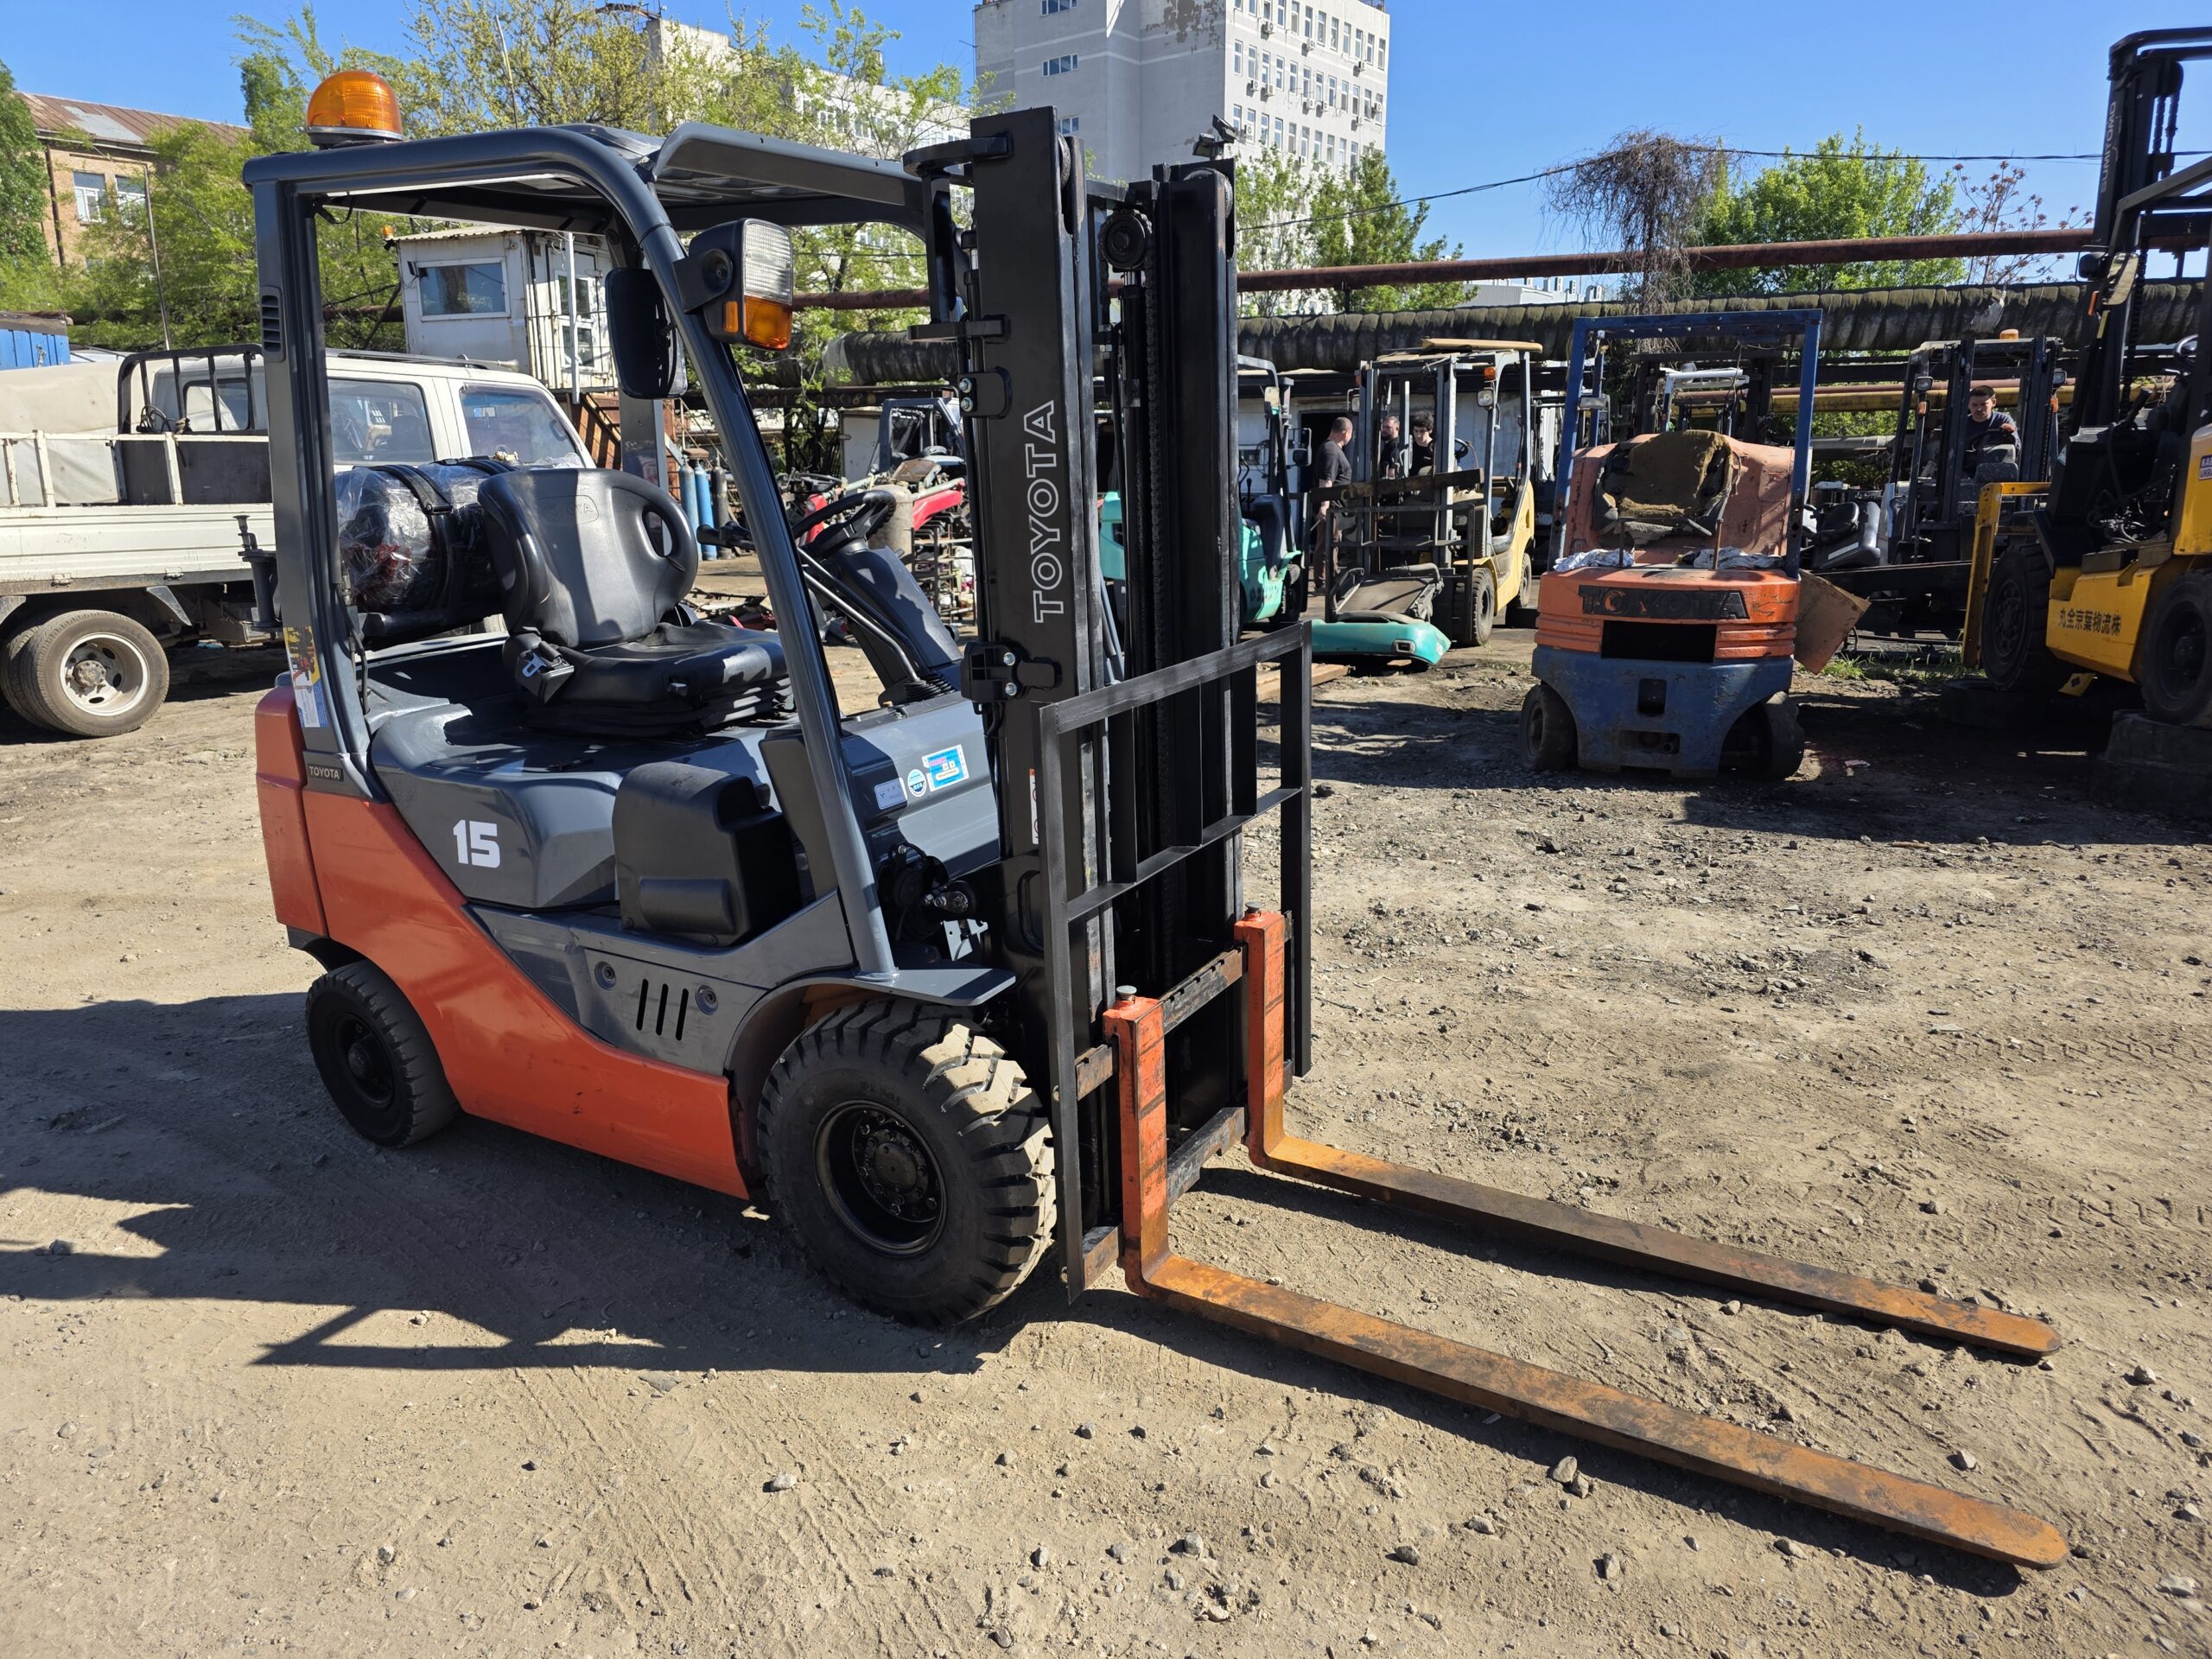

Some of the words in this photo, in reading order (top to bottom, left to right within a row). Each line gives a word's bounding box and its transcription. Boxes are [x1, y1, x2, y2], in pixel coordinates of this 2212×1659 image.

[1023, 399, 1065, 624] TOYOTA
[1579, 584, 1751, 620] TOYOTA
[308, 766, 340, 780] TOYOTA
[453, 819, 501, 868] 15
